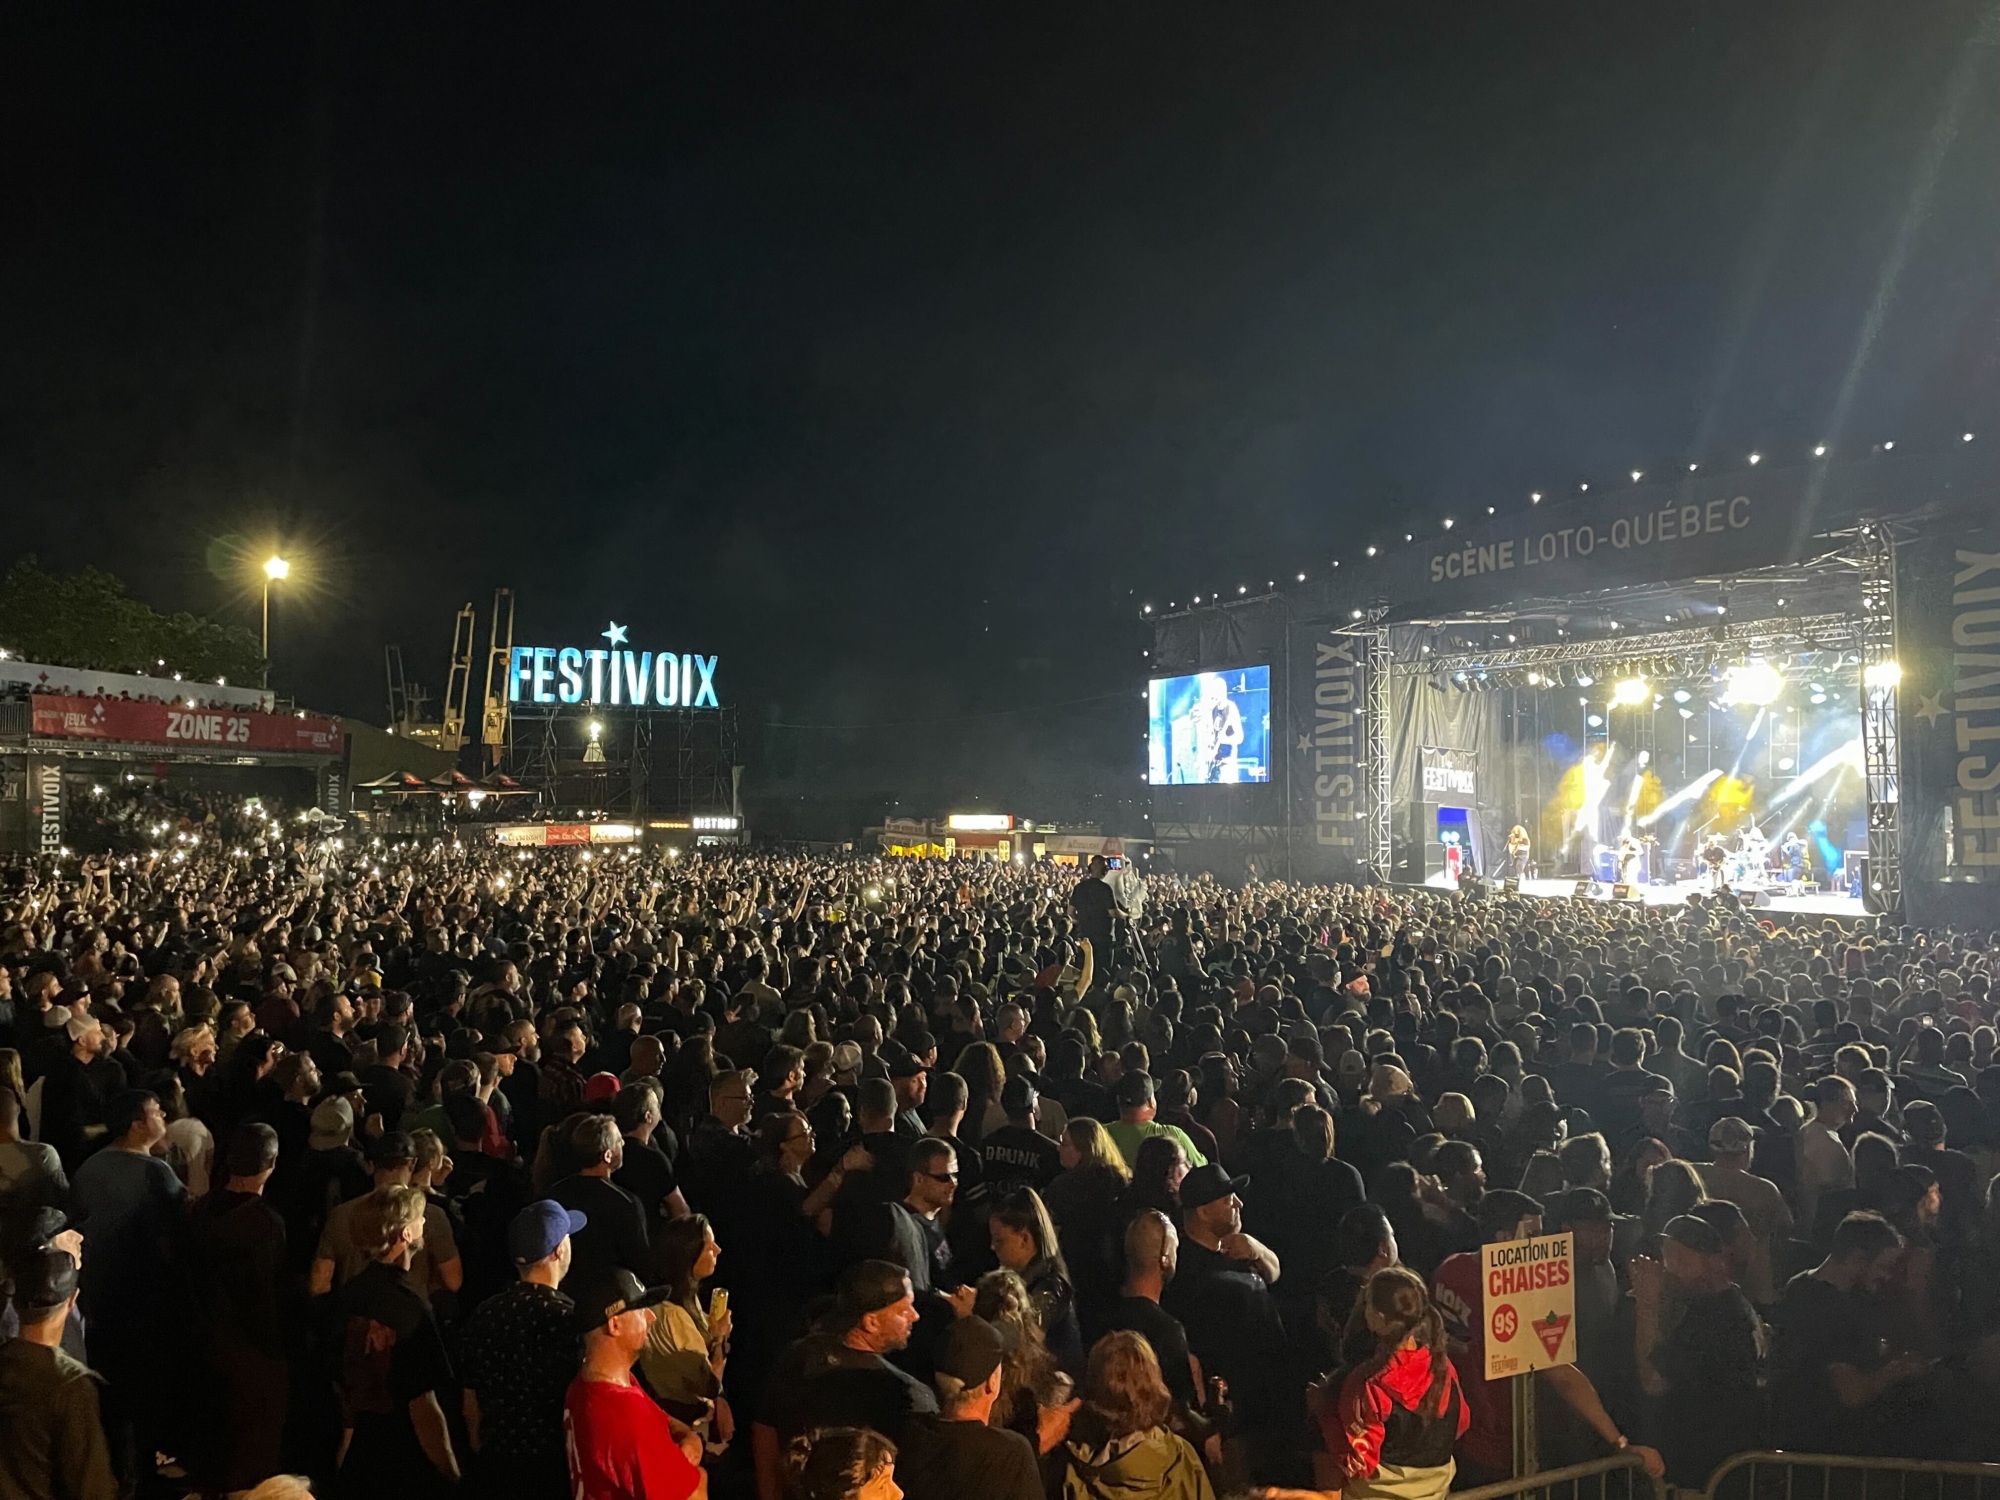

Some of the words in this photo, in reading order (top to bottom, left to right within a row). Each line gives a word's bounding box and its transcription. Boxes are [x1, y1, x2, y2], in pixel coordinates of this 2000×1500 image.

[1430, 539, 1516, 584] SCÈNE
[1523, 494, 1752, 567] LOTO-QUÉBEC
[509, 646, 719, 707] FESTIVOIX
[166, 711, 220, 742] ZONE
[226, 717, 251, 743] 25
[1314, 636, 1355, 847] FESTIVOIX
[41, 764, 61, 856] FESTIVOIX
[986, 1146, 1040, 1169] DRUNK
[1490, 1243, 1548, 1268] LOCATION
[1553, 1240, 1567, 1258] DE
[1489, 1259, 1570, 1298] CHAISES
[1494, 1310, 1515, 1336] 9$
